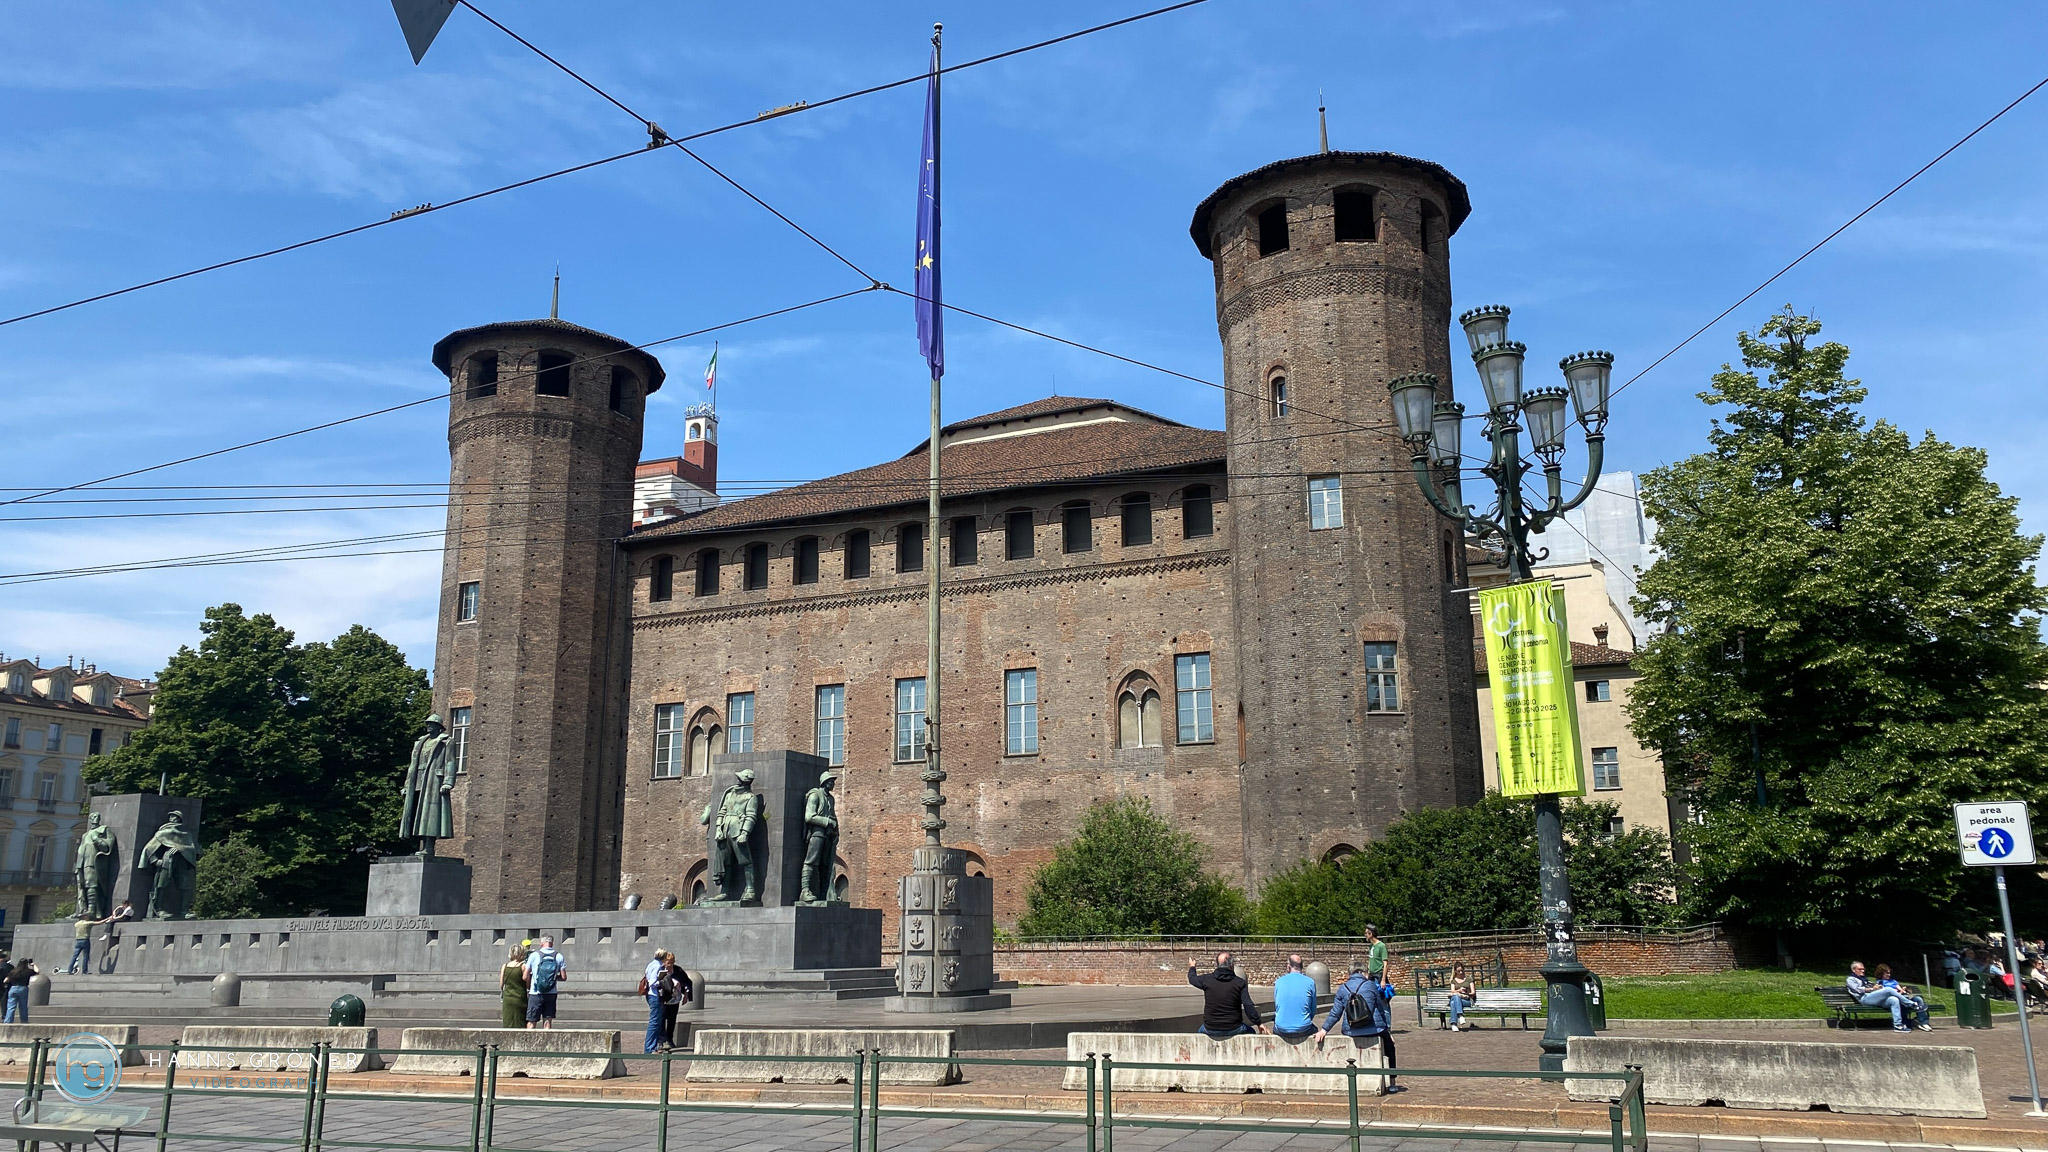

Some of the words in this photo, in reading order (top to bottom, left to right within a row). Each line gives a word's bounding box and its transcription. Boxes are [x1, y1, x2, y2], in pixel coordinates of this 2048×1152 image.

[1506, 652, 1525, 661] NUOVE
[1499, 658, 1536, 669] GENERAZIONI
[1500, 668, 1510, 676] DEL
[1511, 666, 1533, 675] MONDO
[1513, 698, 1536, 707] MAGGIO
[1516, 706, 1539, 714] GIUGNO
[1541, 703, 1557, 712] 2025
[1979, 807, 2002, 815] area
[1969, 816, 2015, 826] pedonale
